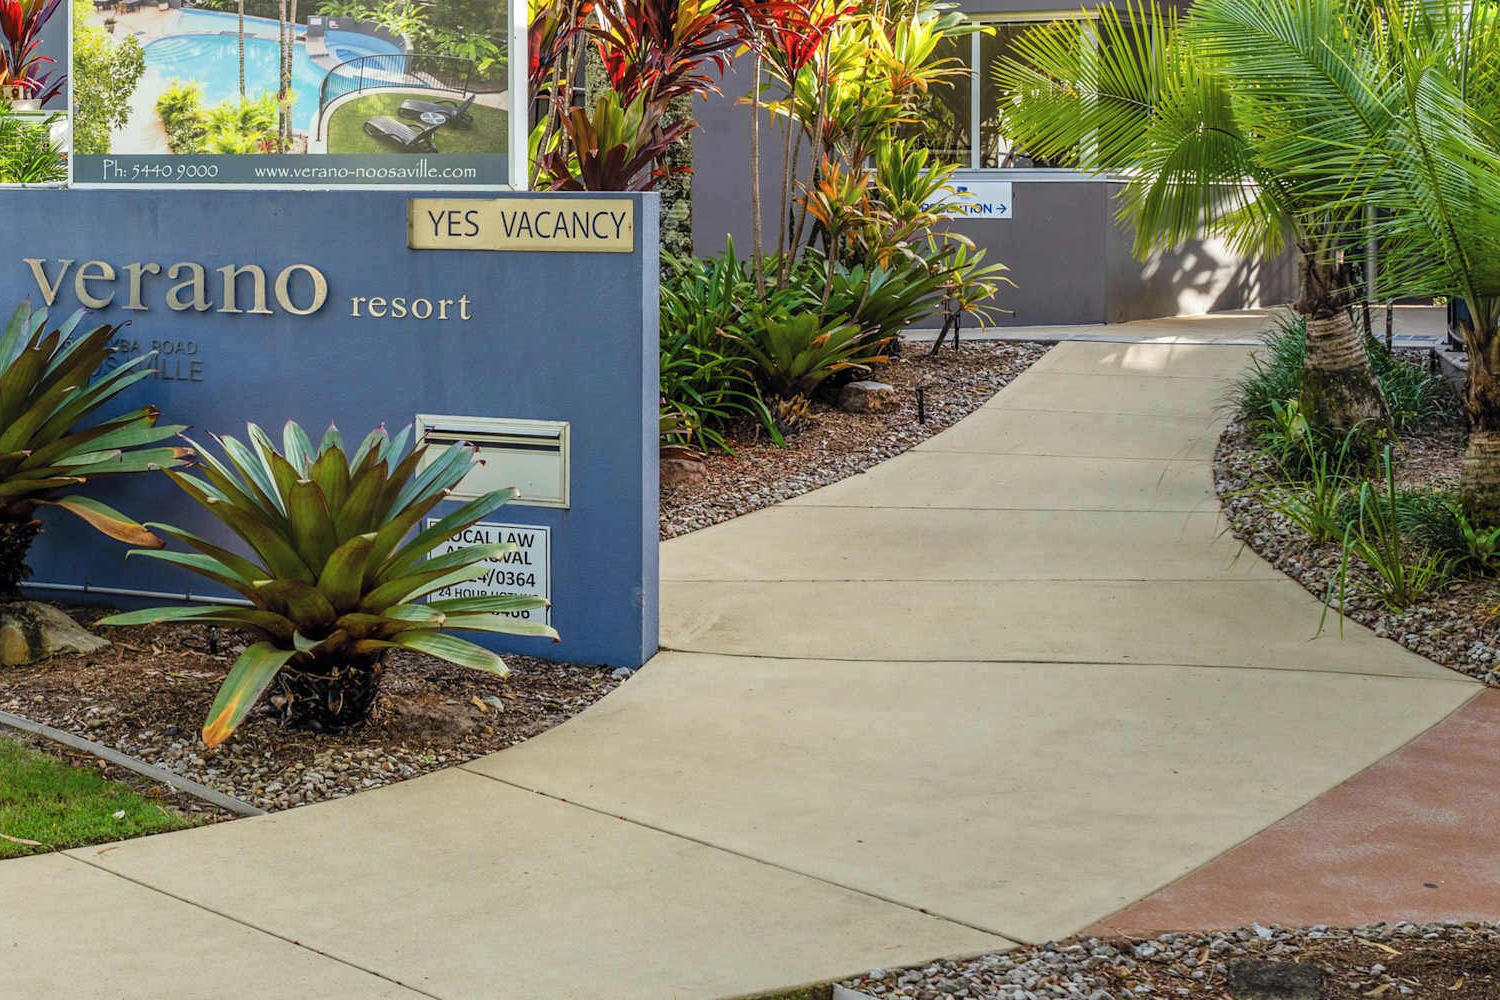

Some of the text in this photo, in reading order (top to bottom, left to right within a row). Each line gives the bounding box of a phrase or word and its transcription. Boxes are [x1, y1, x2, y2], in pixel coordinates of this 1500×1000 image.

[102, 159, 477, 180] Ph: 5440 9000 www.verano-noosaville.com
[427, 210, 626, 240] YES VACANCY
[22, 257, 473, 321] verano resort
[446, 530, 492, 545] OCAL
